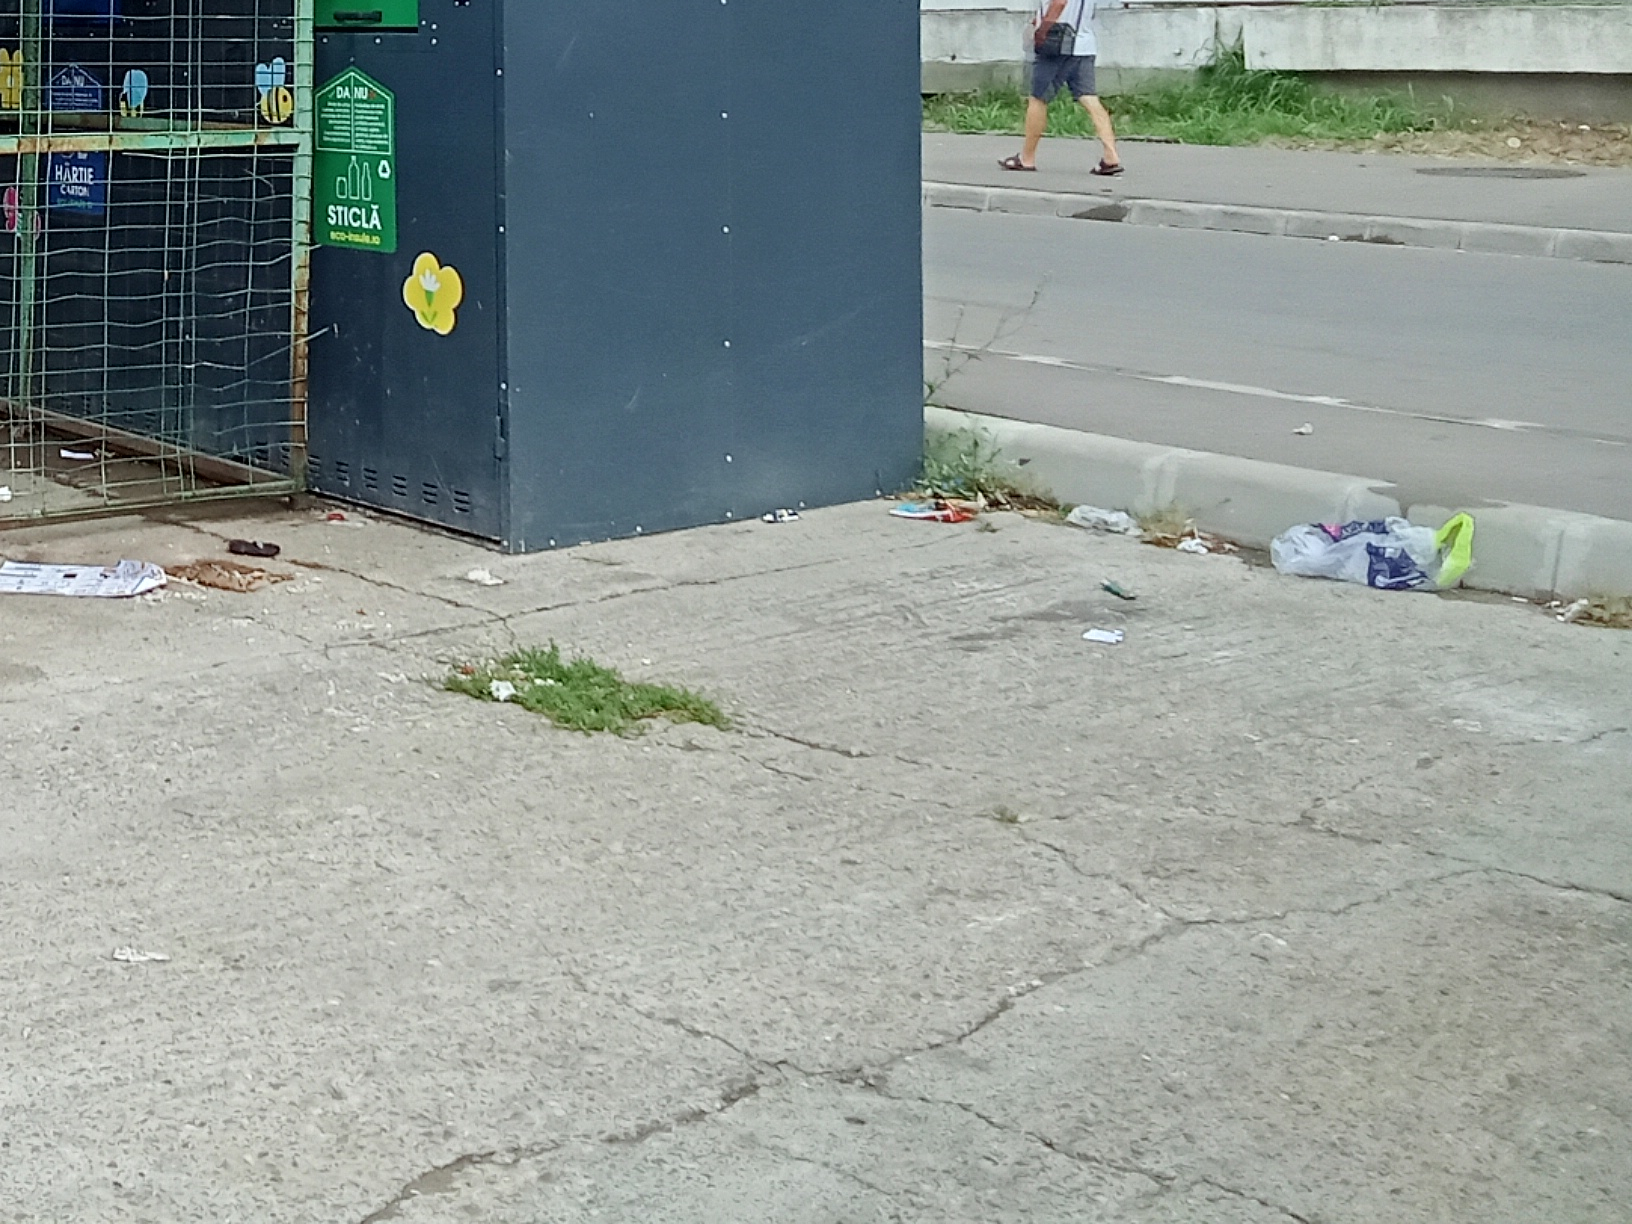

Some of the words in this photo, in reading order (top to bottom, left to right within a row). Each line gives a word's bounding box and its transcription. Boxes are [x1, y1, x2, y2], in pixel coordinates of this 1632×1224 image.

[335, 86, 351, 99] DA
[354, 86, 368, 100] NU
[327, 203, 382, 231] STICLĂ
